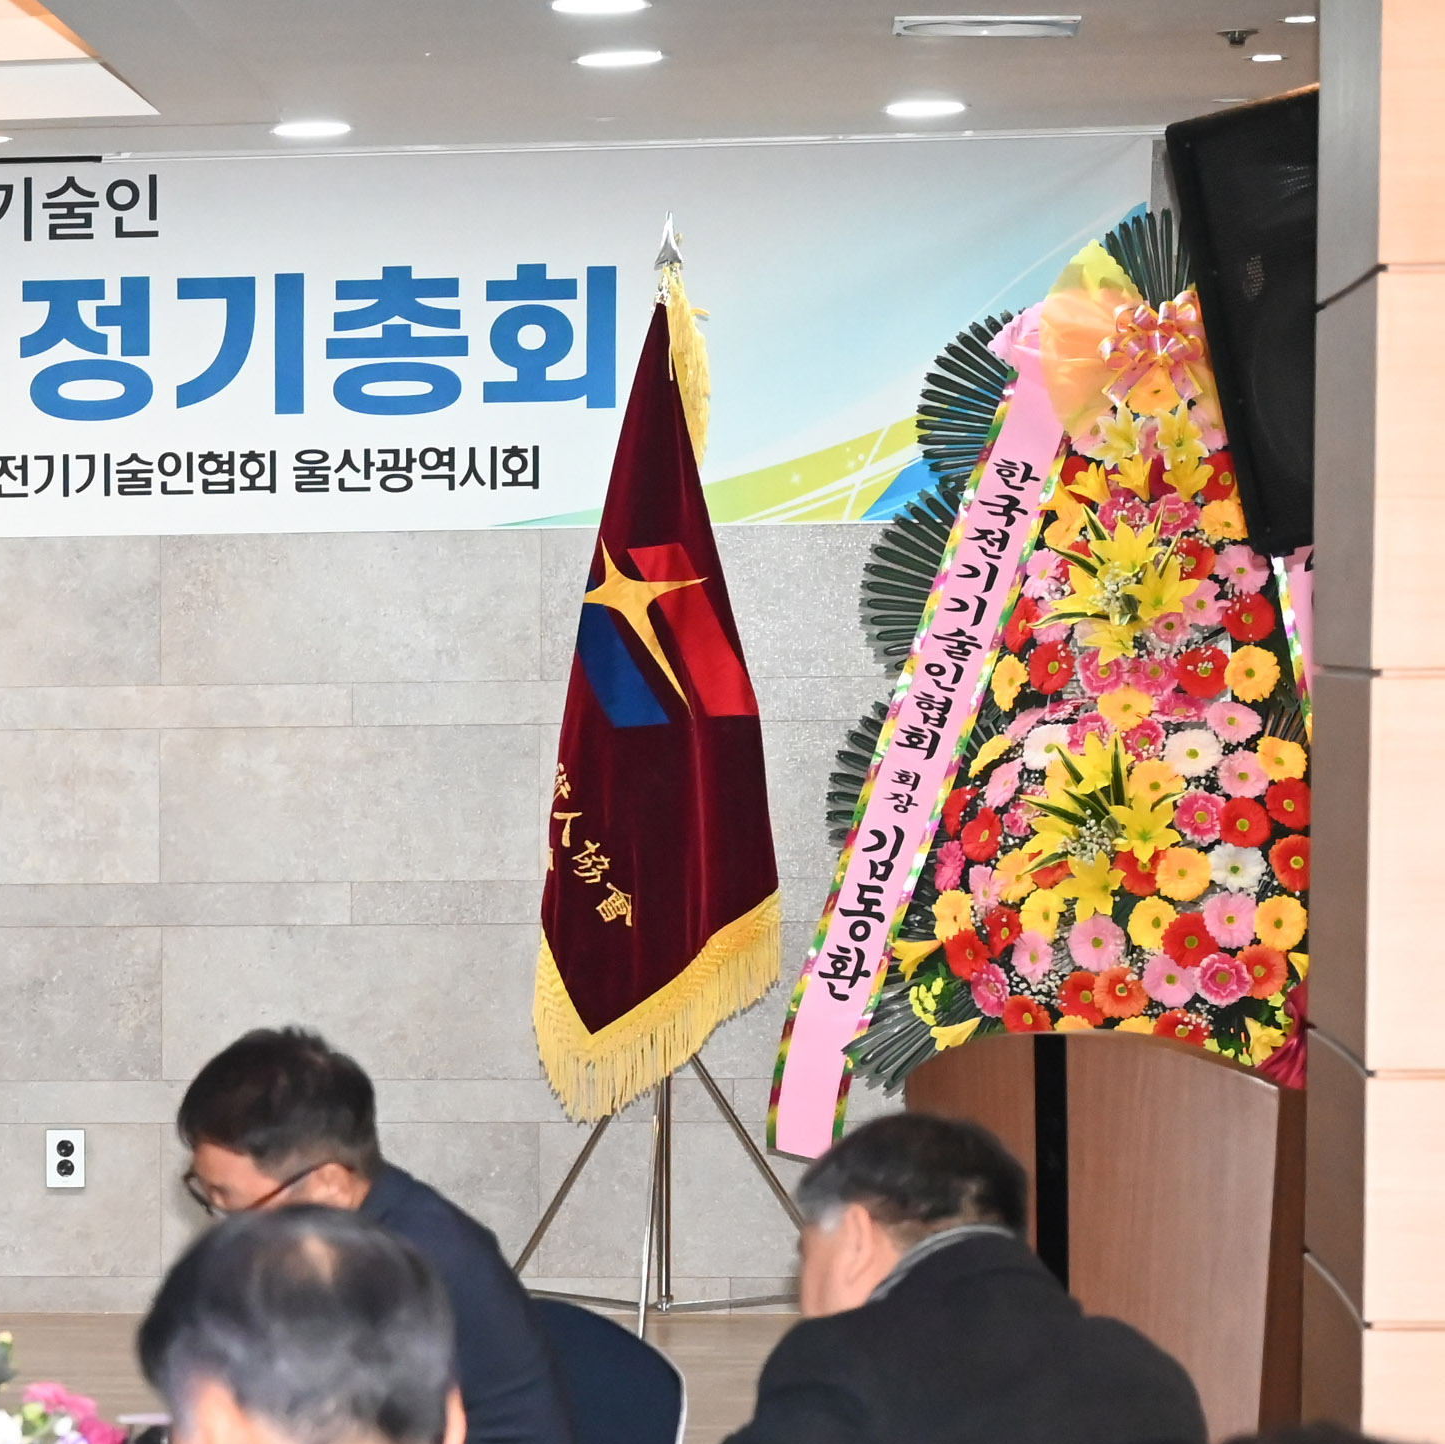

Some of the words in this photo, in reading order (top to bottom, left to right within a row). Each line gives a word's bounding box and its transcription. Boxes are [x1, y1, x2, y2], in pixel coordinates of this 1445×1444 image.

[20, 264, 617, 422] 정기총회
[293, 446, 539, 492] 울산광역시회
[895, 458, 1041, 760] 한국전기기술인협회
[883, 768, 922, 814] 회장
[818, 825, 906, 1002] 김동환
